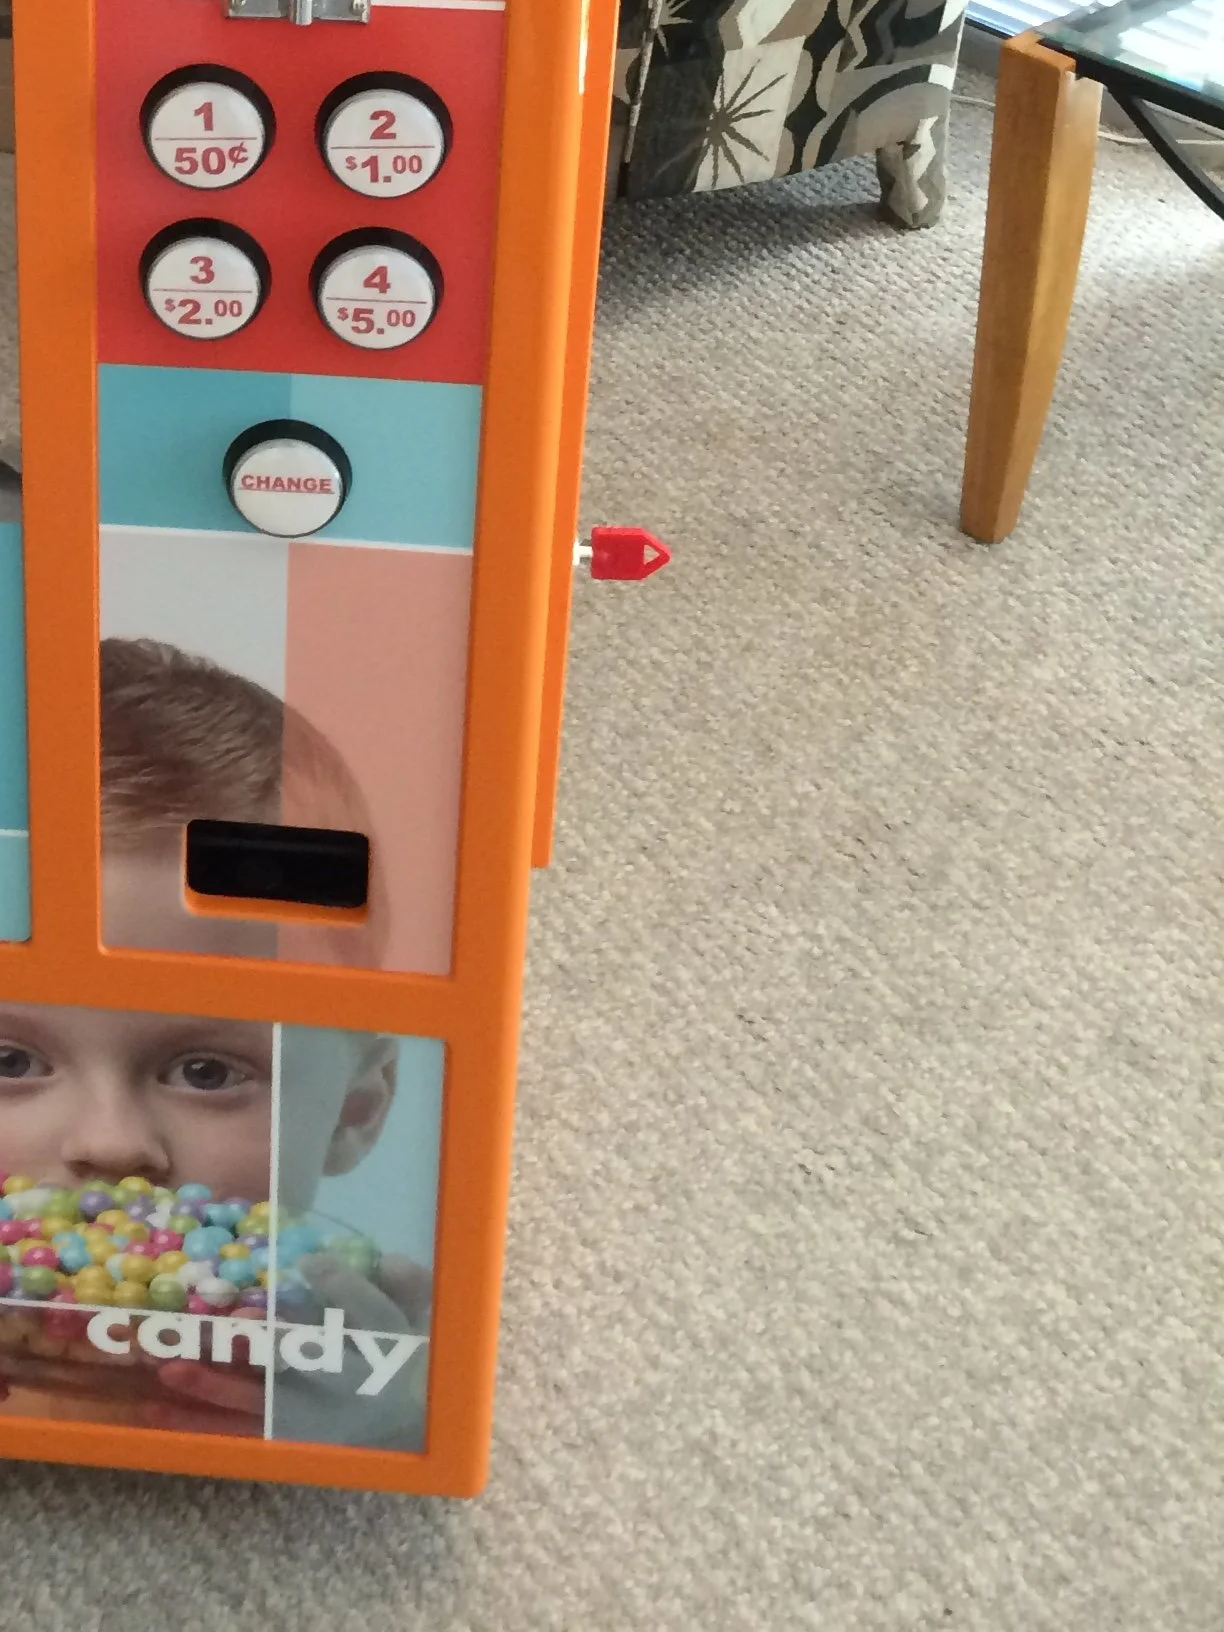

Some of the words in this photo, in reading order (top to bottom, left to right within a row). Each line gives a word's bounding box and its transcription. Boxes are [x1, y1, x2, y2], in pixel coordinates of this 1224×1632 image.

[193, 102, 214, 132] 1
[369, 110, 397, 140] 2
[174, 142, 249, 175] 50¢
[345, 155, 423, 184] $1.00
[189, 256, 215, 284] 3
[363, 266, 391, 294] 4
[164, 298, 243, 325] $2.00
[337, 307, 416, 335] $5.00
[240, 474, 332, 492] CHANGE
[86, 1307, 426, 1396] candy
